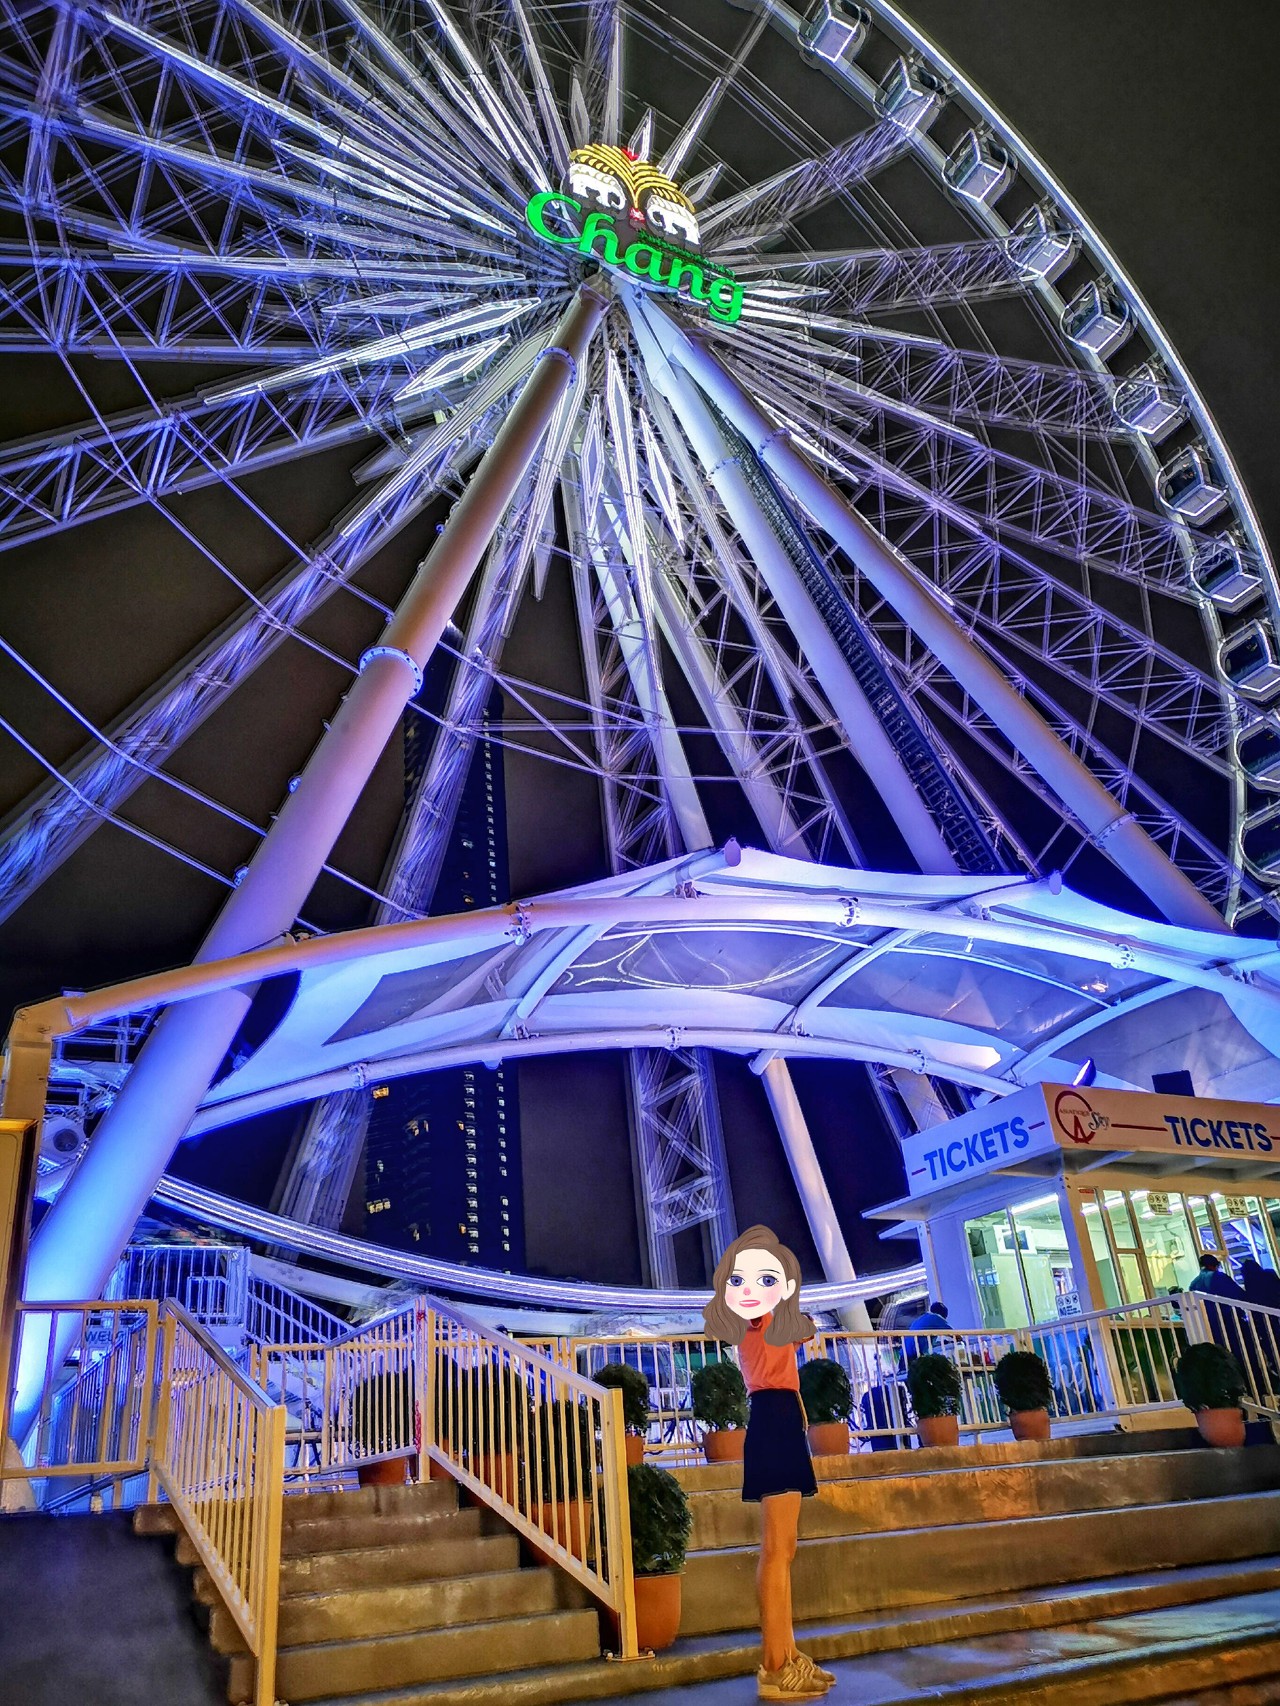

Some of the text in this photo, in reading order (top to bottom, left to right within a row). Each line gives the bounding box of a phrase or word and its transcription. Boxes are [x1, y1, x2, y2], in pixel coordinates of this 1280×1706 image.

[525, 192, 744, 323] Chang
[923, 1116, 1029, 1181] TICKETS
[1164, 1115, 1273, 1152] TICKETS
